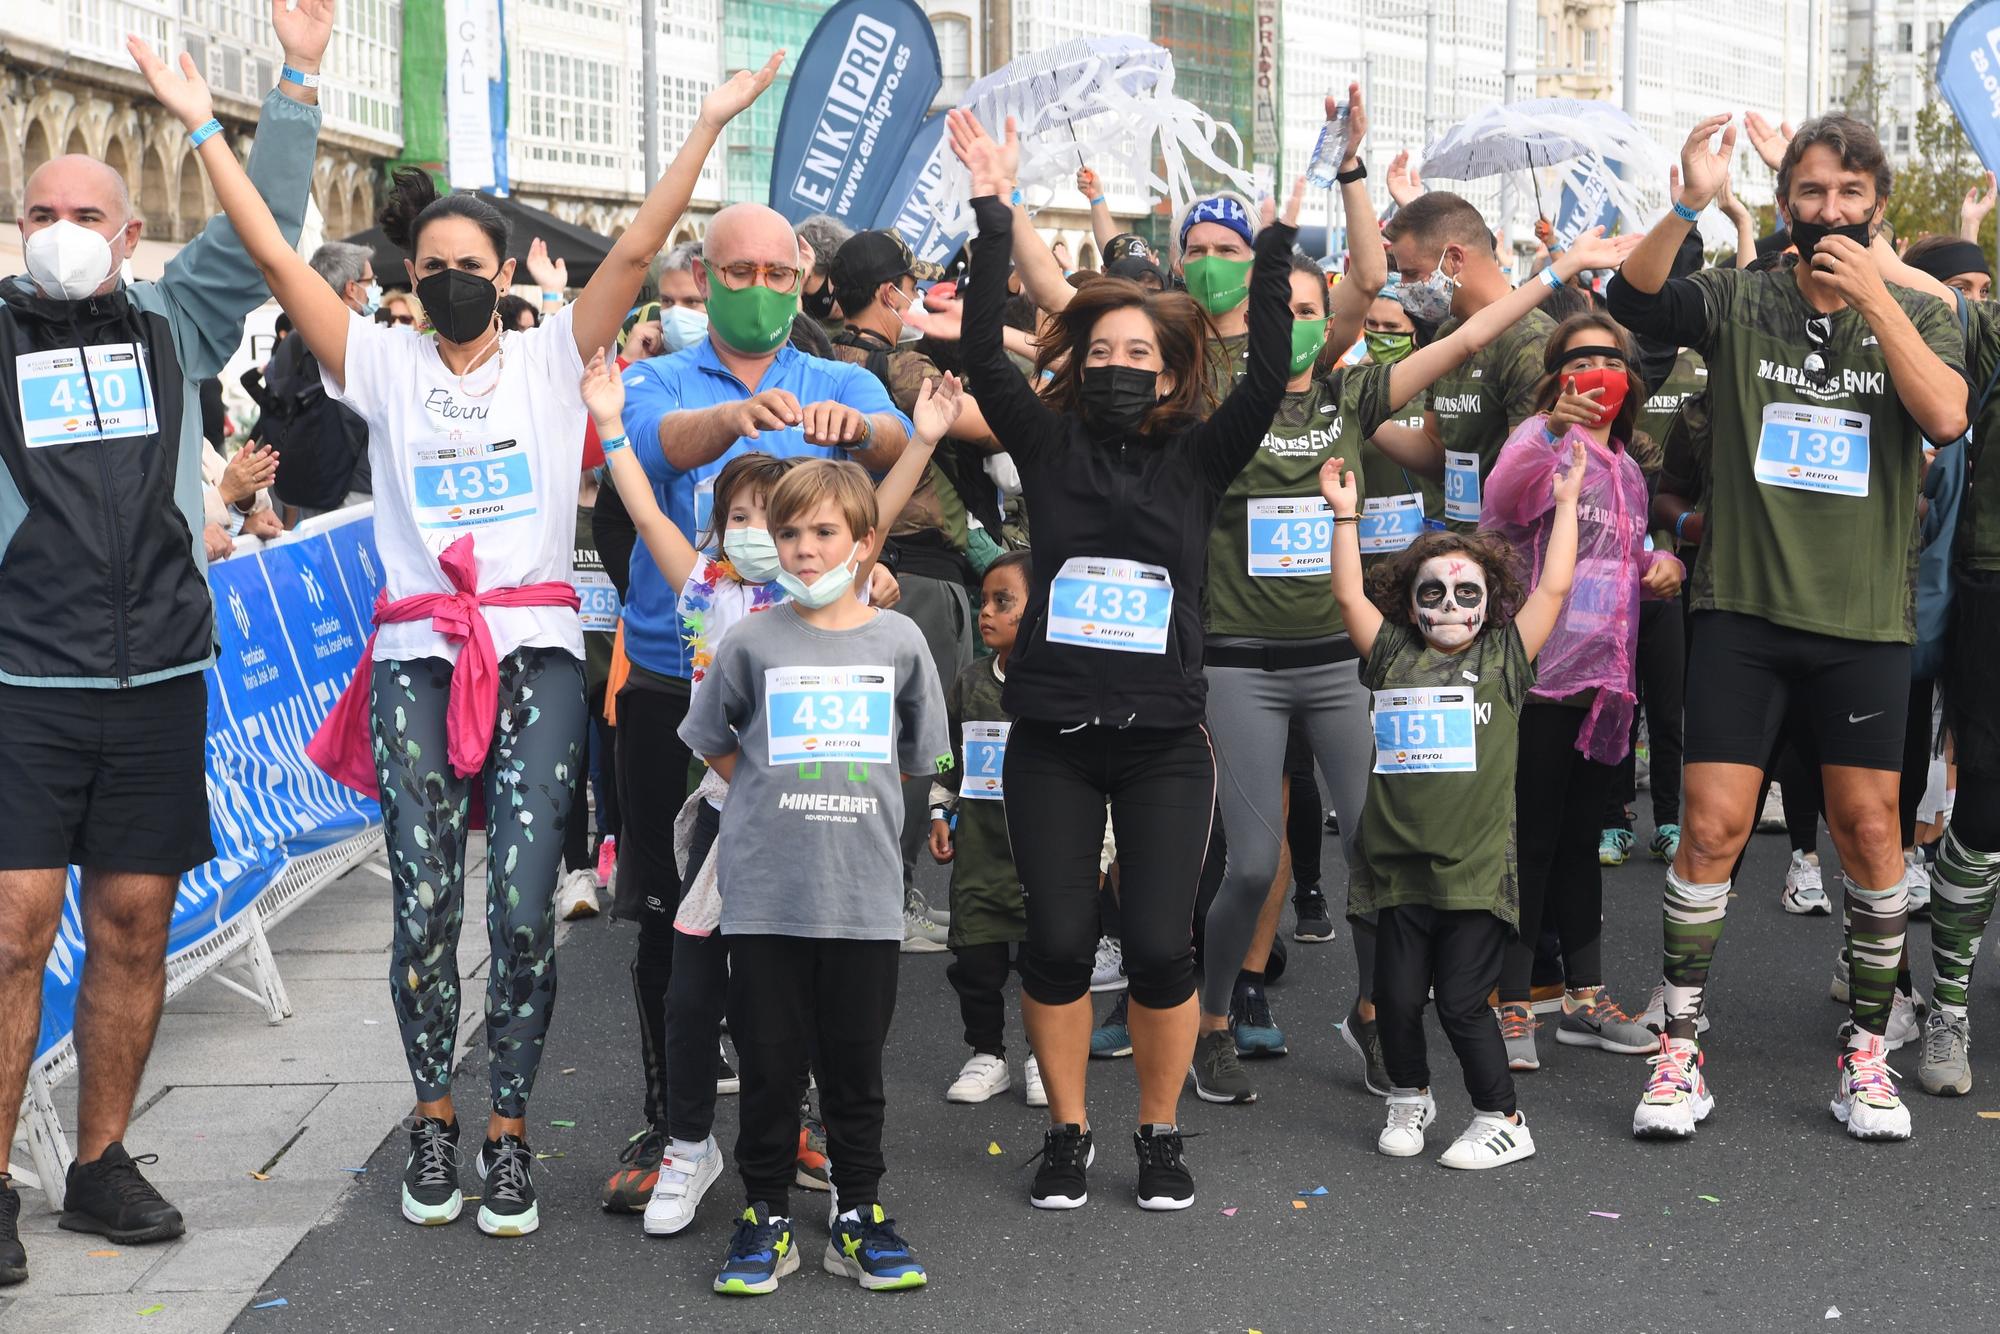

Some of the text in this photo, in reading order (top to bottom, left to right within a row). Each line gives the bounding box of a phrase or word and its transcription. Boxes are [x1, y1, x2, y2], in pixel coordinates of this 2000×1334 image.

[836, 44, 911, 216] www.enkipro.es
[50, 373, 126, 412] 430
[1843, 368, 1885, 395] ENKI
[1310, 416, 1343, 450] ENKI
[457, 446, 481, 458] ENKI
[1787, 430, 1851, 466] 139
[436, 462, 509, 501] 435
[1805, 471, 1839, 481] REPSOL
[469, 504, 505, 516] REPSOL
[1271, 520, 1331, 551] 439
[1373, 512, 1403, 536] 22
[1296, 556, 1324, 565] REPSOL
[578, 589, 616, 612] 265
[1075, 584, 1147, 622] 433
[1101, 628, 1135, 638] REPSOL
[792, 695, 870, 731] 434
[1390, 713, 1446, 746] 151
[825, 739, 861, 748] REPSOL
[981, 745, 1005, 774] 2
[778, 792, 878, 815] MINECRAFT
[805, 814, 858, 824] ADVENTURE CLUB
